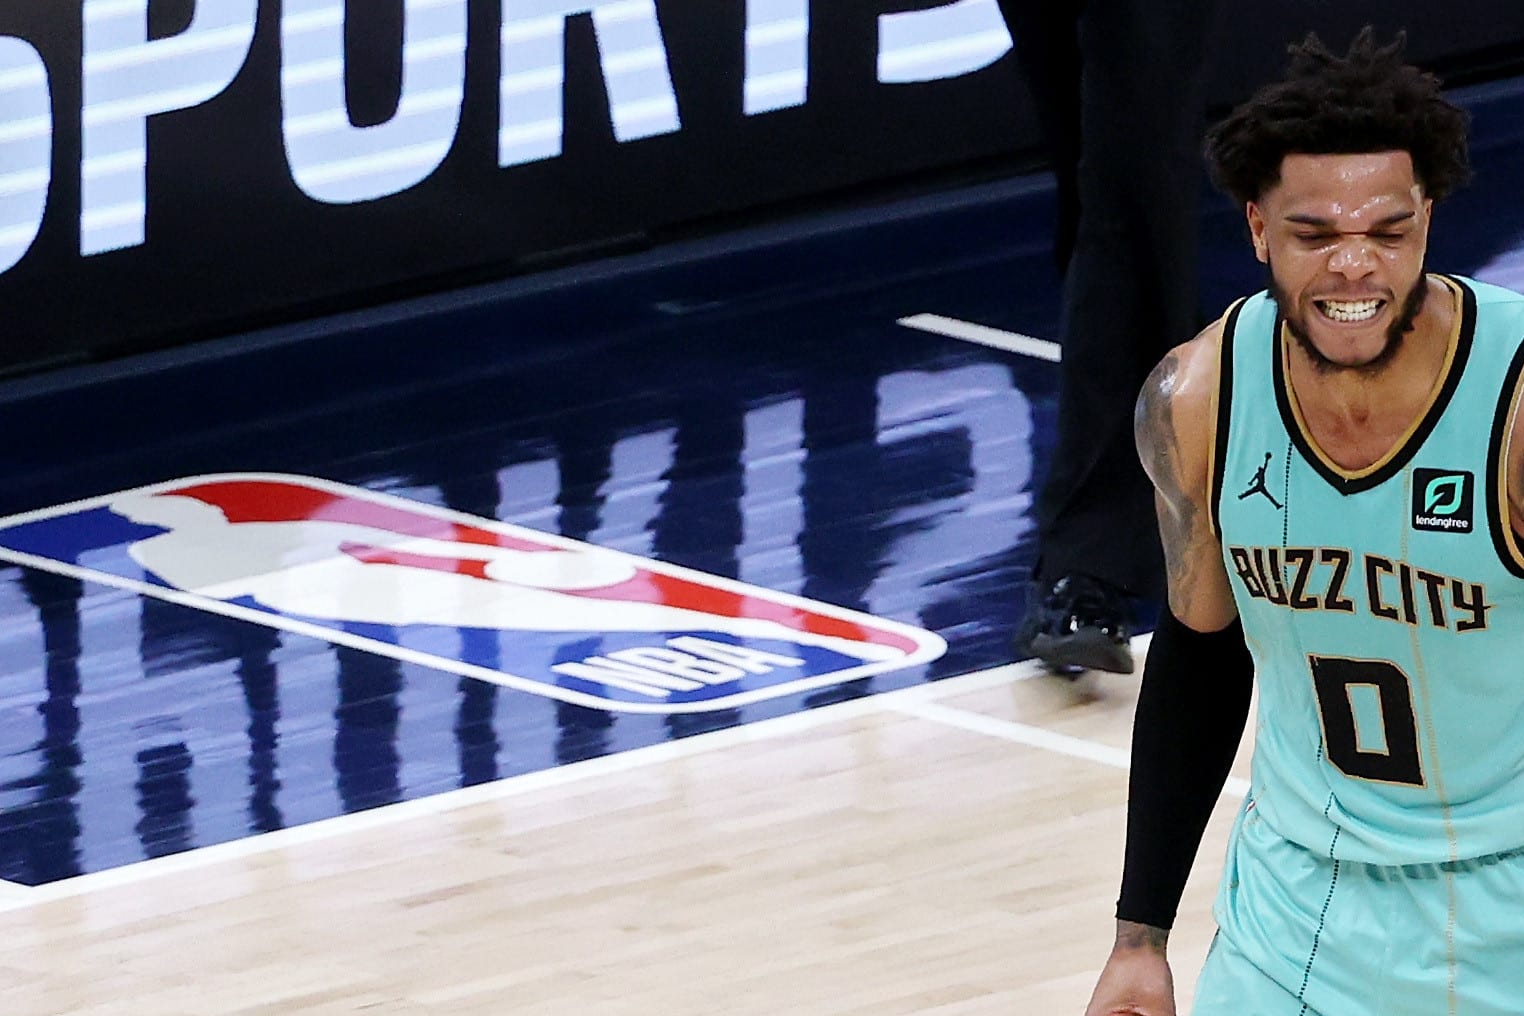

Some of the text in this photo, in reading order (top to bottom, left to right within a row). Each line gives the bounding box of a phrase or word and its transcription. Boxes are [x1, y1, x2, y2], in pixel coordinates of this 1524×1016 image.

[0, 0, 1015, 273] POR
[1415, 514, 1469, 529] lendingtree
[1229, 546, 1496, 634] BUZZ CITY
[550, 635, 807, 699] NBA
[1306, 652, 1428, 789] 0
